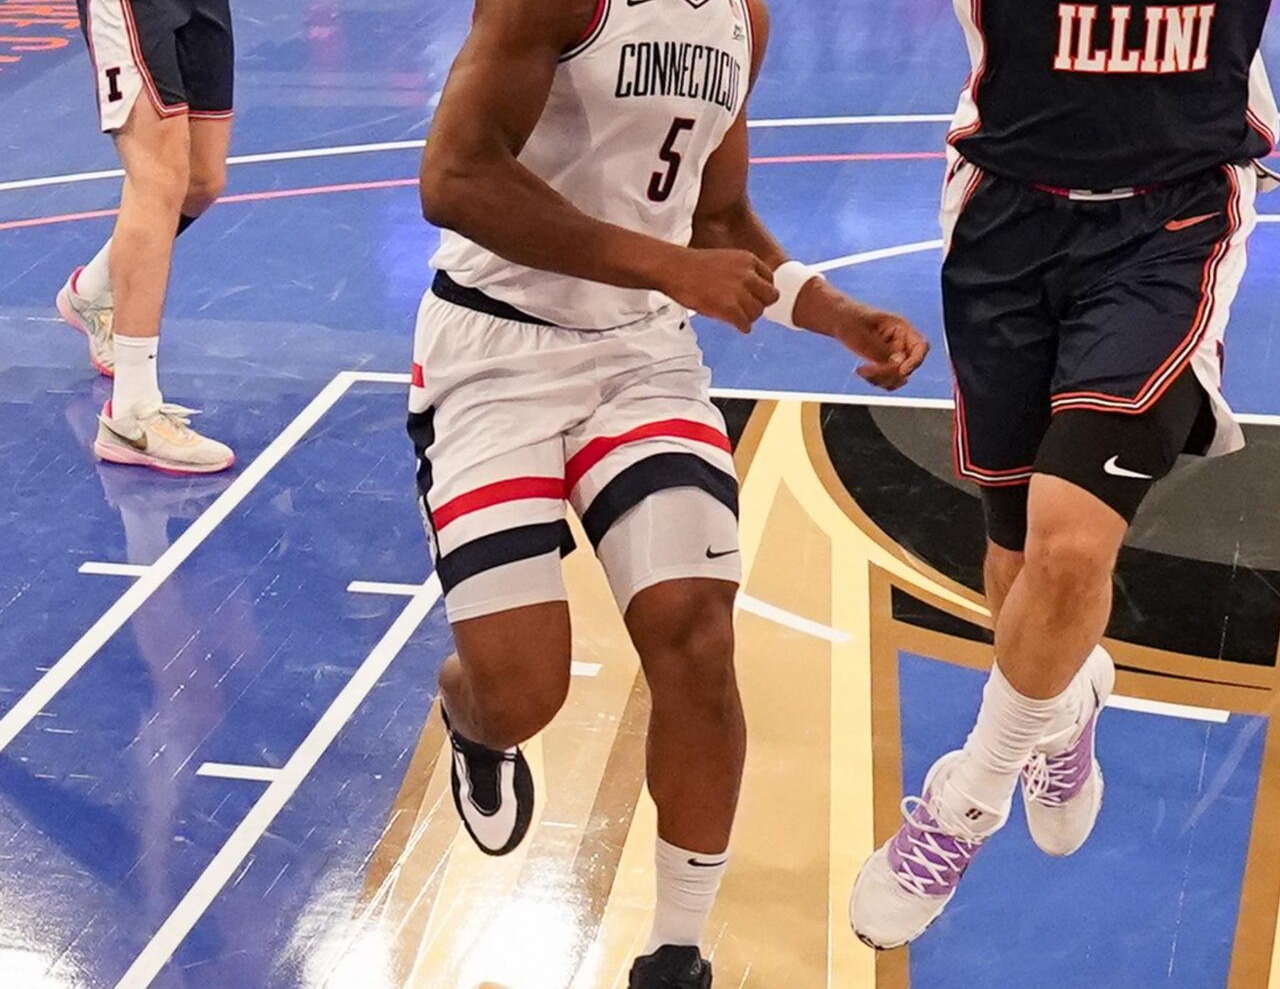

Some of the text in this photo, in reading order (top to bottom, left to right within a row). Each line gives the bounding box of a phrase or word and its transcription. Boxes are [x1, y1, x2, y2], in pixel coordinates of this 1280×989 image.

[1053, 3, 1216, 73] ILLINI
[105, 66, 123, 102] I
[615, 41, 741, 116] CONNECTICUT
[647, 117, 696, 202] 5
